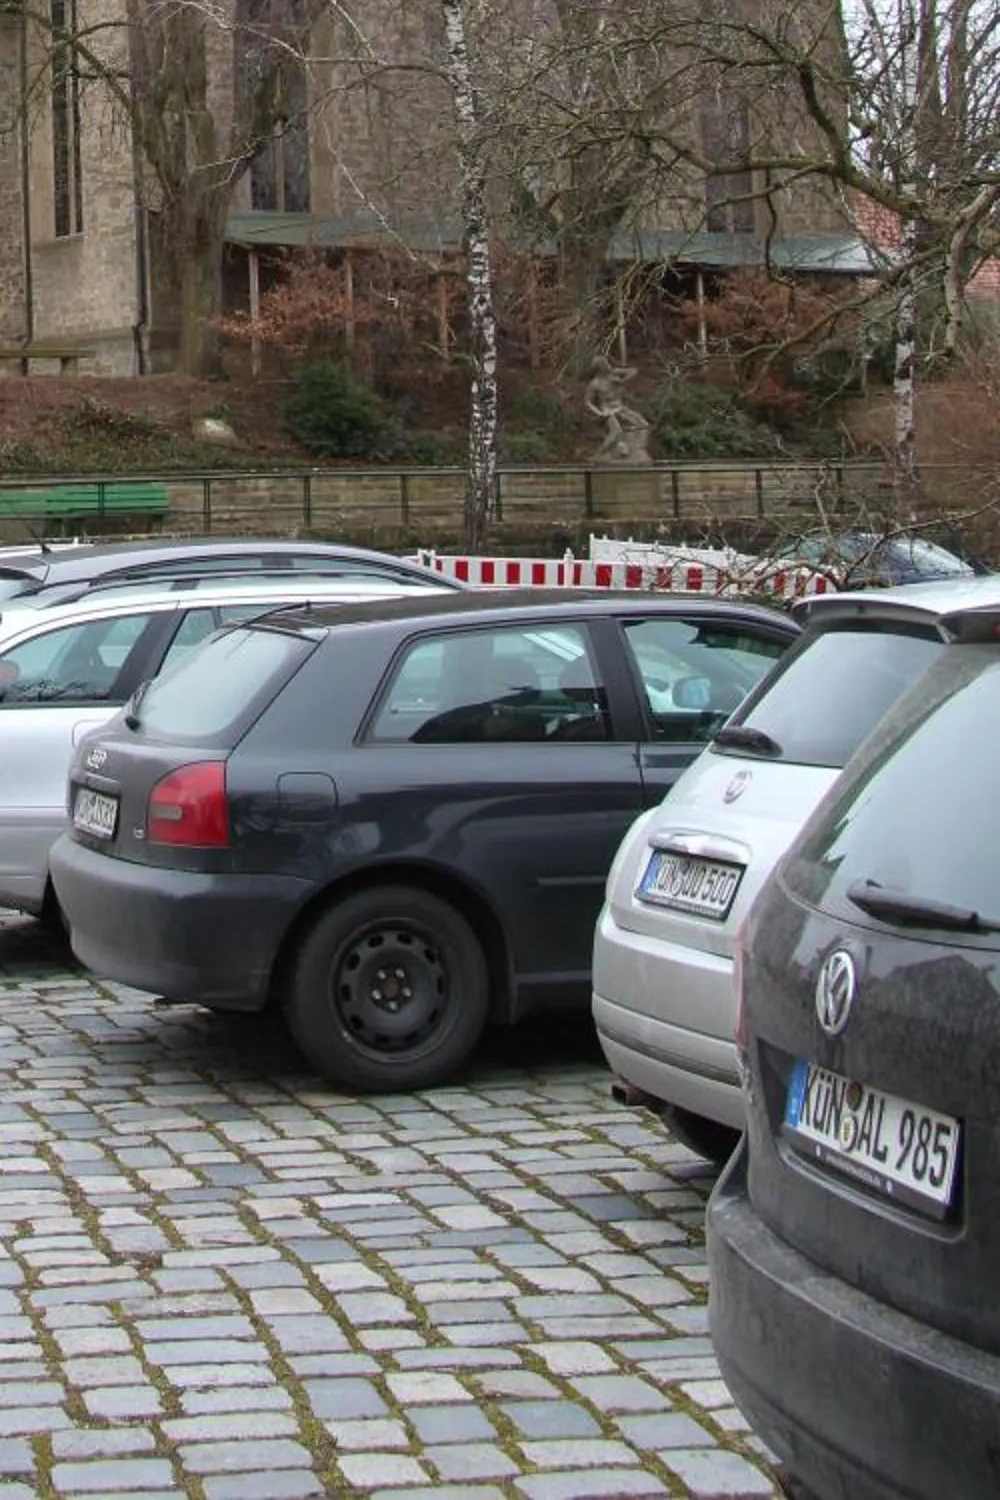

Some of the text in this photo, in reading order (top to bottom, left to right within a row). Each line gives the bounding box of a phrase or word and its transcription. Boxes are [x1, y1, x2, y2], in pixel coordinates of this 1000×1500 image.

[701, 867, 737, 905] 500
[800, 1062, 847, 1142] KÜN
[857, 1093, 889, 1164] AL
[895, 1107, 951, 1189] 985
